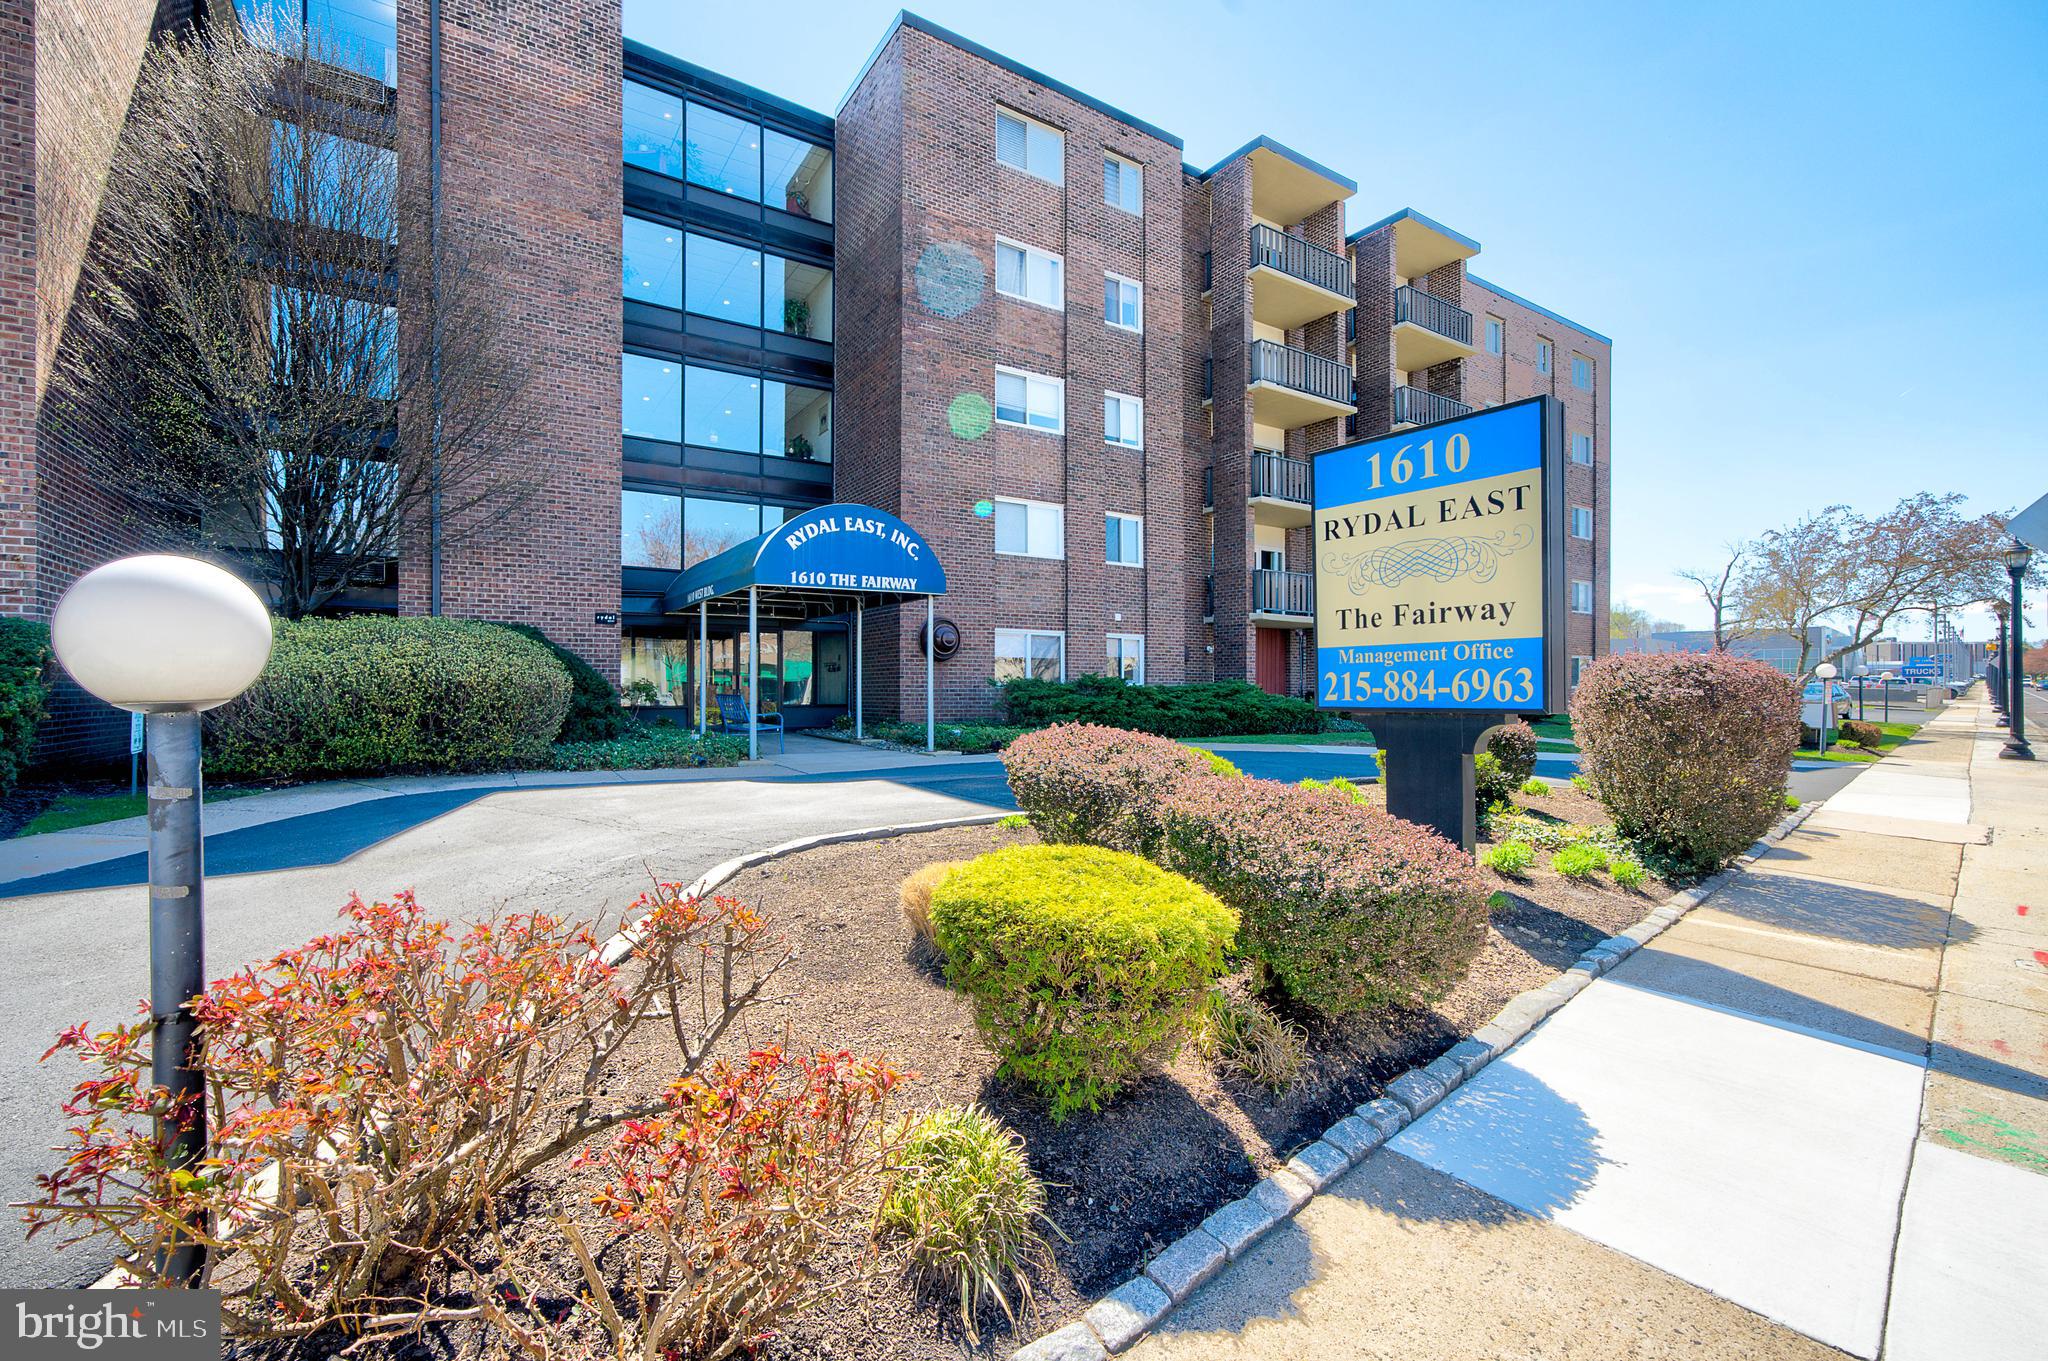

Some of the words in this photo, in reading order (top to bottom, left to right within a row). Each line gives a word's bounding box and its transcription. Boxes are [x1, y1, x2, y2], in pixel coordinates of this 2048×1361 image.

[1367, 433, 1470, 490] 1610
[1323, 505, 1426, 541] RYDAL
[1437, 485, 1531, 523] EAST
[785, 517, 840, 551] RYDAL
[844, 516, 887, 539] EAST,
[890, 528, 920, 561] INC.
[790, 570, 827, 585] 1610
[830, 573, 858, 587] THE
[861, 575, 918, 591] FAIRWAY
[1336, 608, 1382, 630] The
[1392, 601, 1516, 627] Fairway
[1338, 646, 1448, 666] Management
[1453, 643, 1515, 661] Office
[1323, 667, 1534, 702] 215-884-6963
